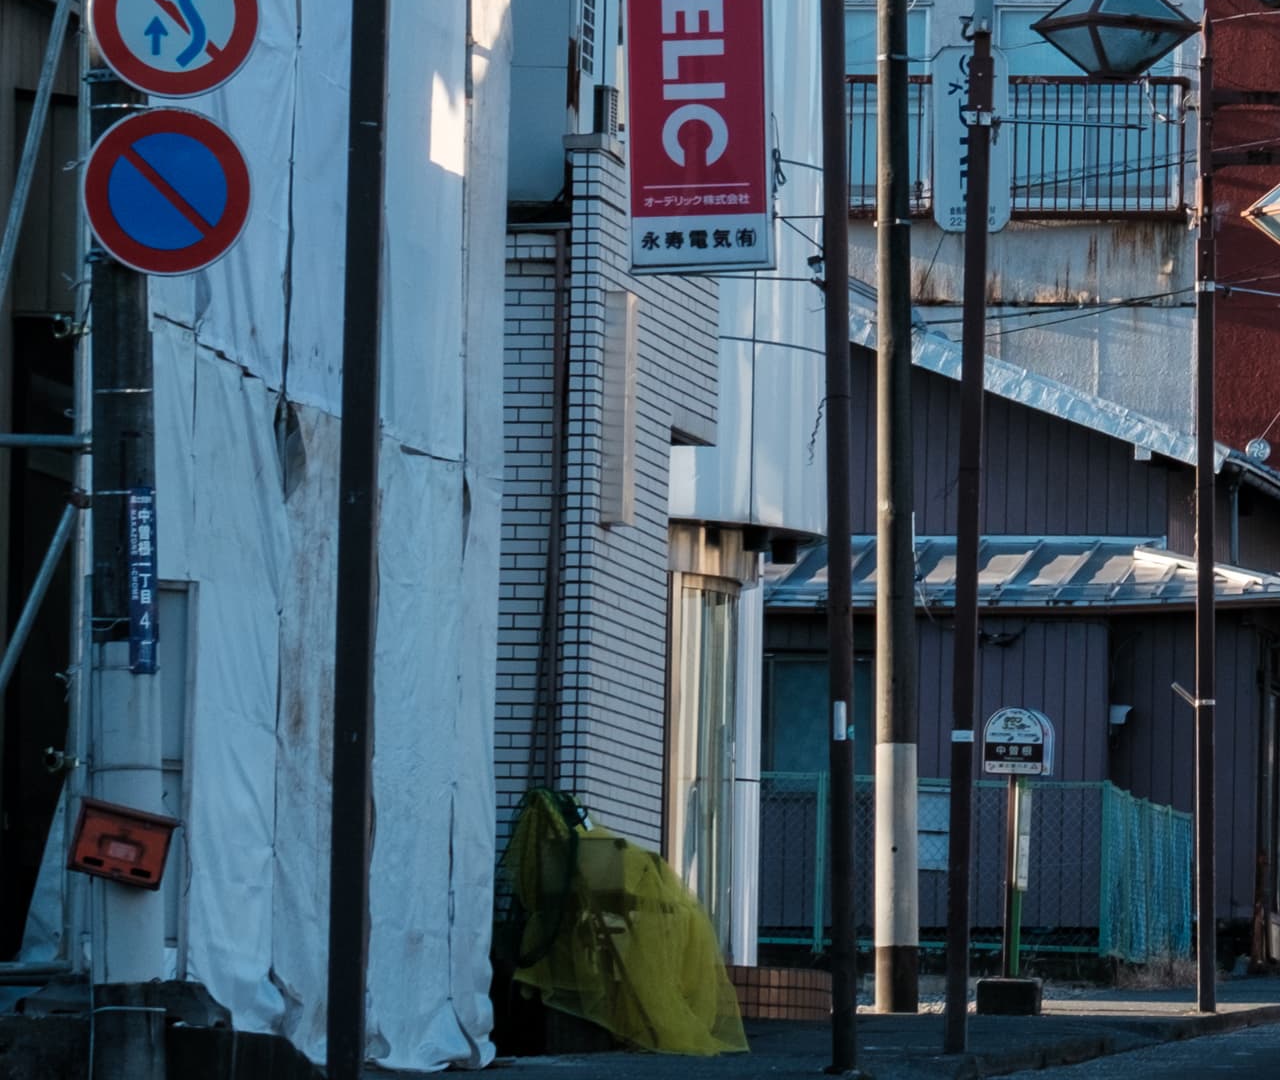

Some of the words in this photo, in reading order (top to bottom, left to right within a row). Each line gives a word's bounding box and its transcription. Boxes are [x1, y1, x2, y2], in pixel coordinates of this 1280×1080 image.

[644, 193, 750, 207] オーデリック株式会社
